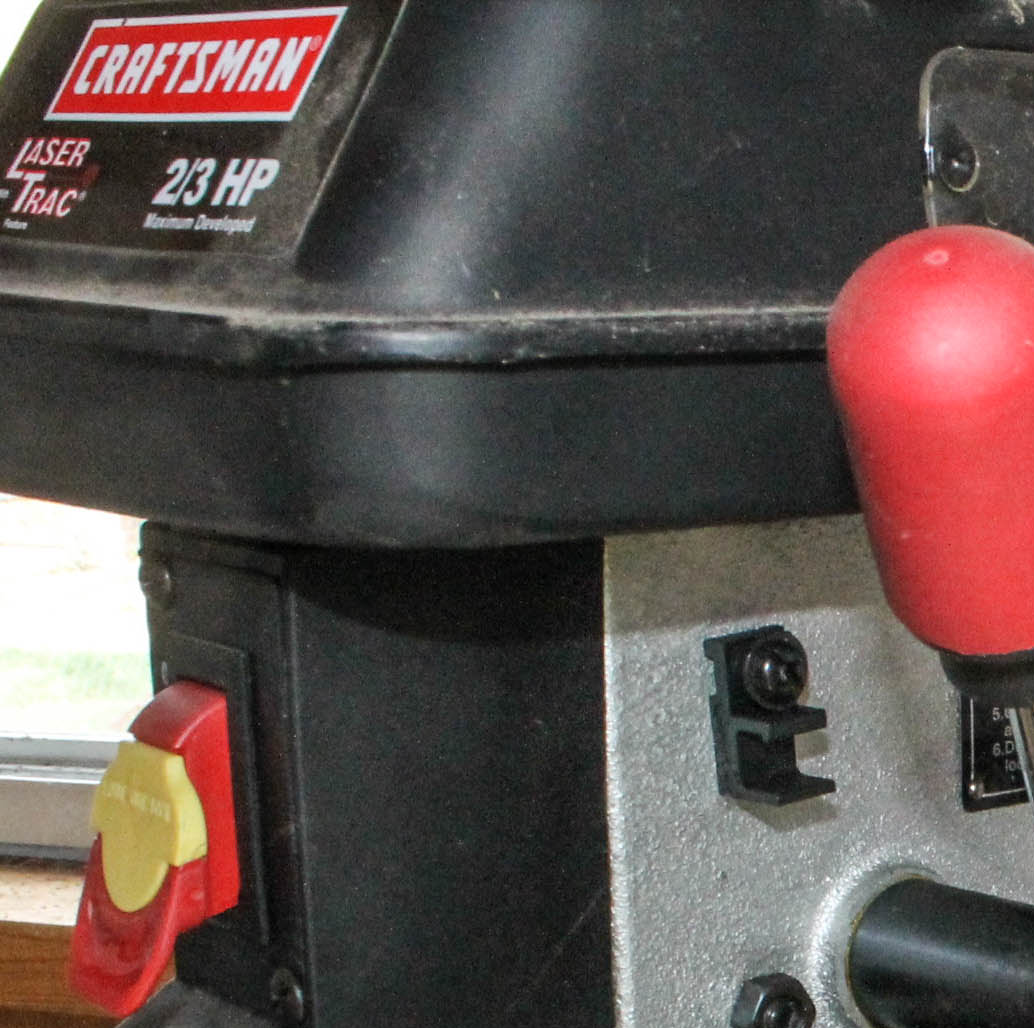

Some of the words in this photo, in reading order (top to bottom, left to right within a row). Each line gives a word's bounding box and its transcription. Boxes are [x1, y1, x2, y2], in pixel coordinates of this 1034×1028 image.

[73, 37, 312, 94] CRAFTSMAN
[6, 137, 91, 178] LASER
[151, 157, 218, 207] 2/3
[210, 157, 280, 207] HP
